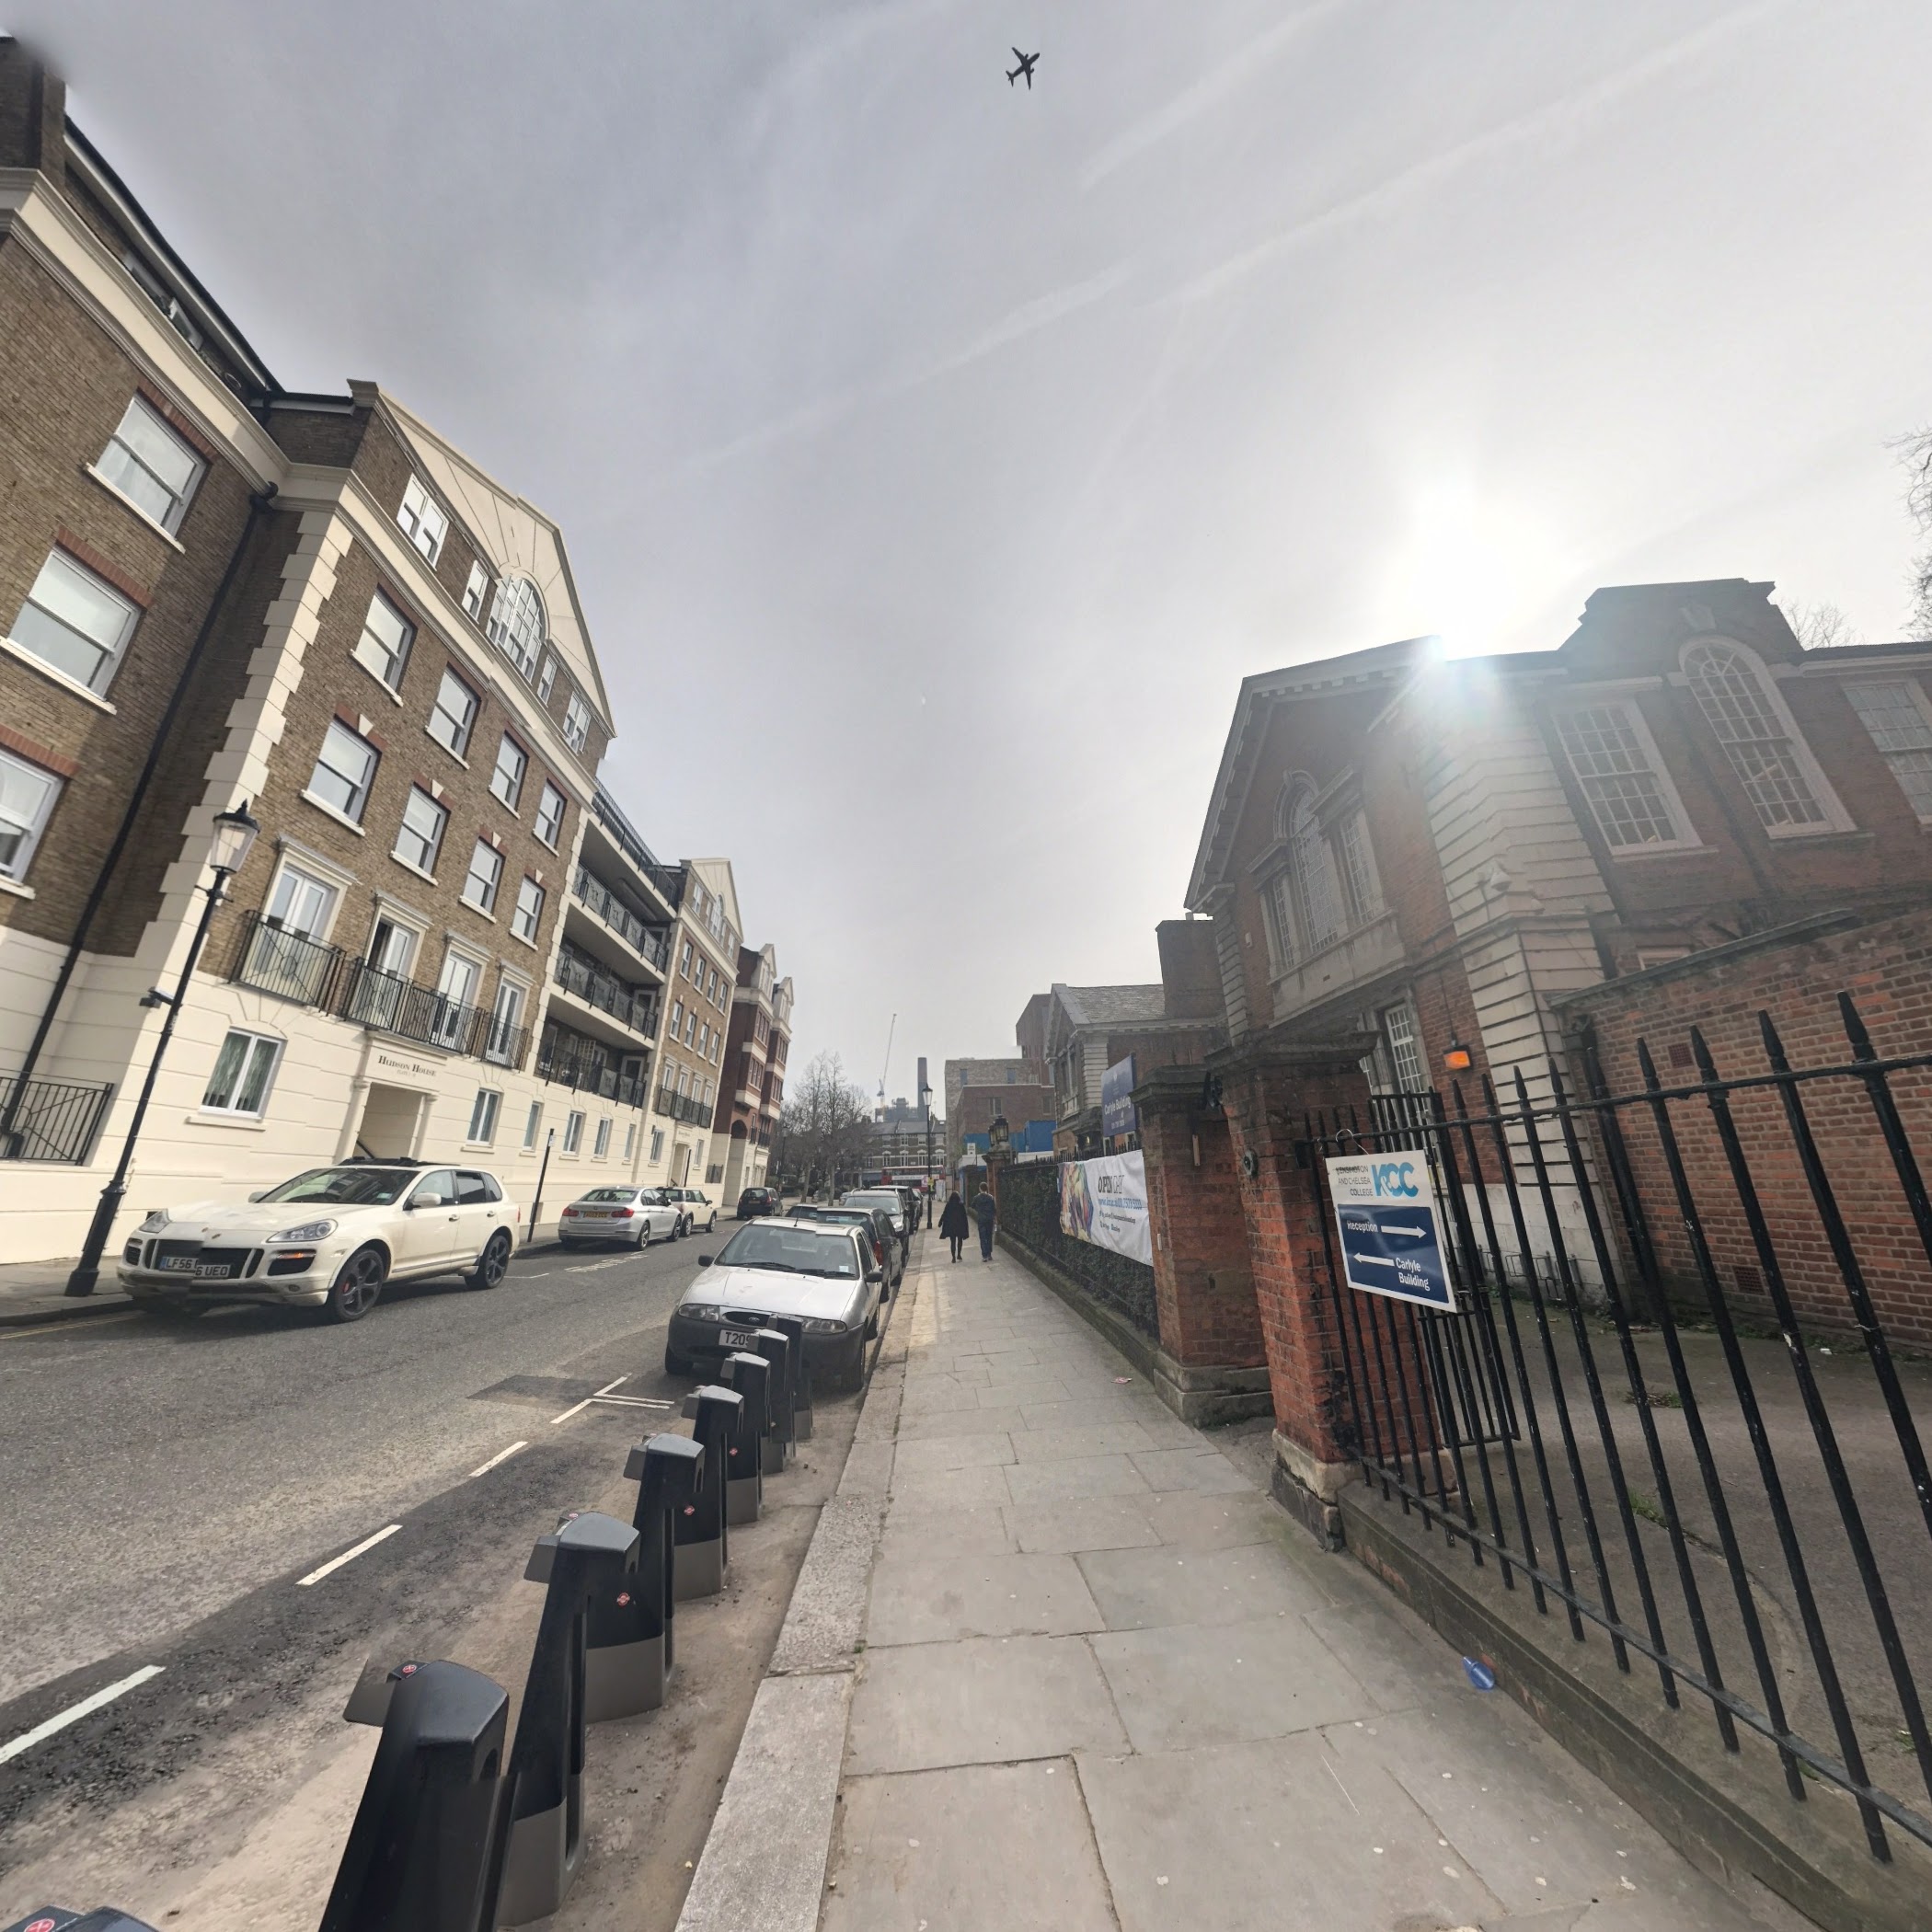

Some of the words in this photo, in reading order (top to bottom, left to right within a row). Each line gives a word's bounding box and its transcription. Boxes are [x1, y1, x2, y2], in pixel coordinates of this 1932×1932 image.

[1116, 1095, 1132, 1110] Building
[1098, 1176, 1112, 1193] OPEN
[1113, 1175, 1124, 1194] DAY
[1348, 1177, 1371, 1185] CHELSEA
[1350, 1188, 1374, 1197] COLLEGE
[1347, 1220, 1379, 1233] Reception
[1396, 1257, 1421, 1273] Carlyle
[1398, 1271, 1431, 1292] Building
